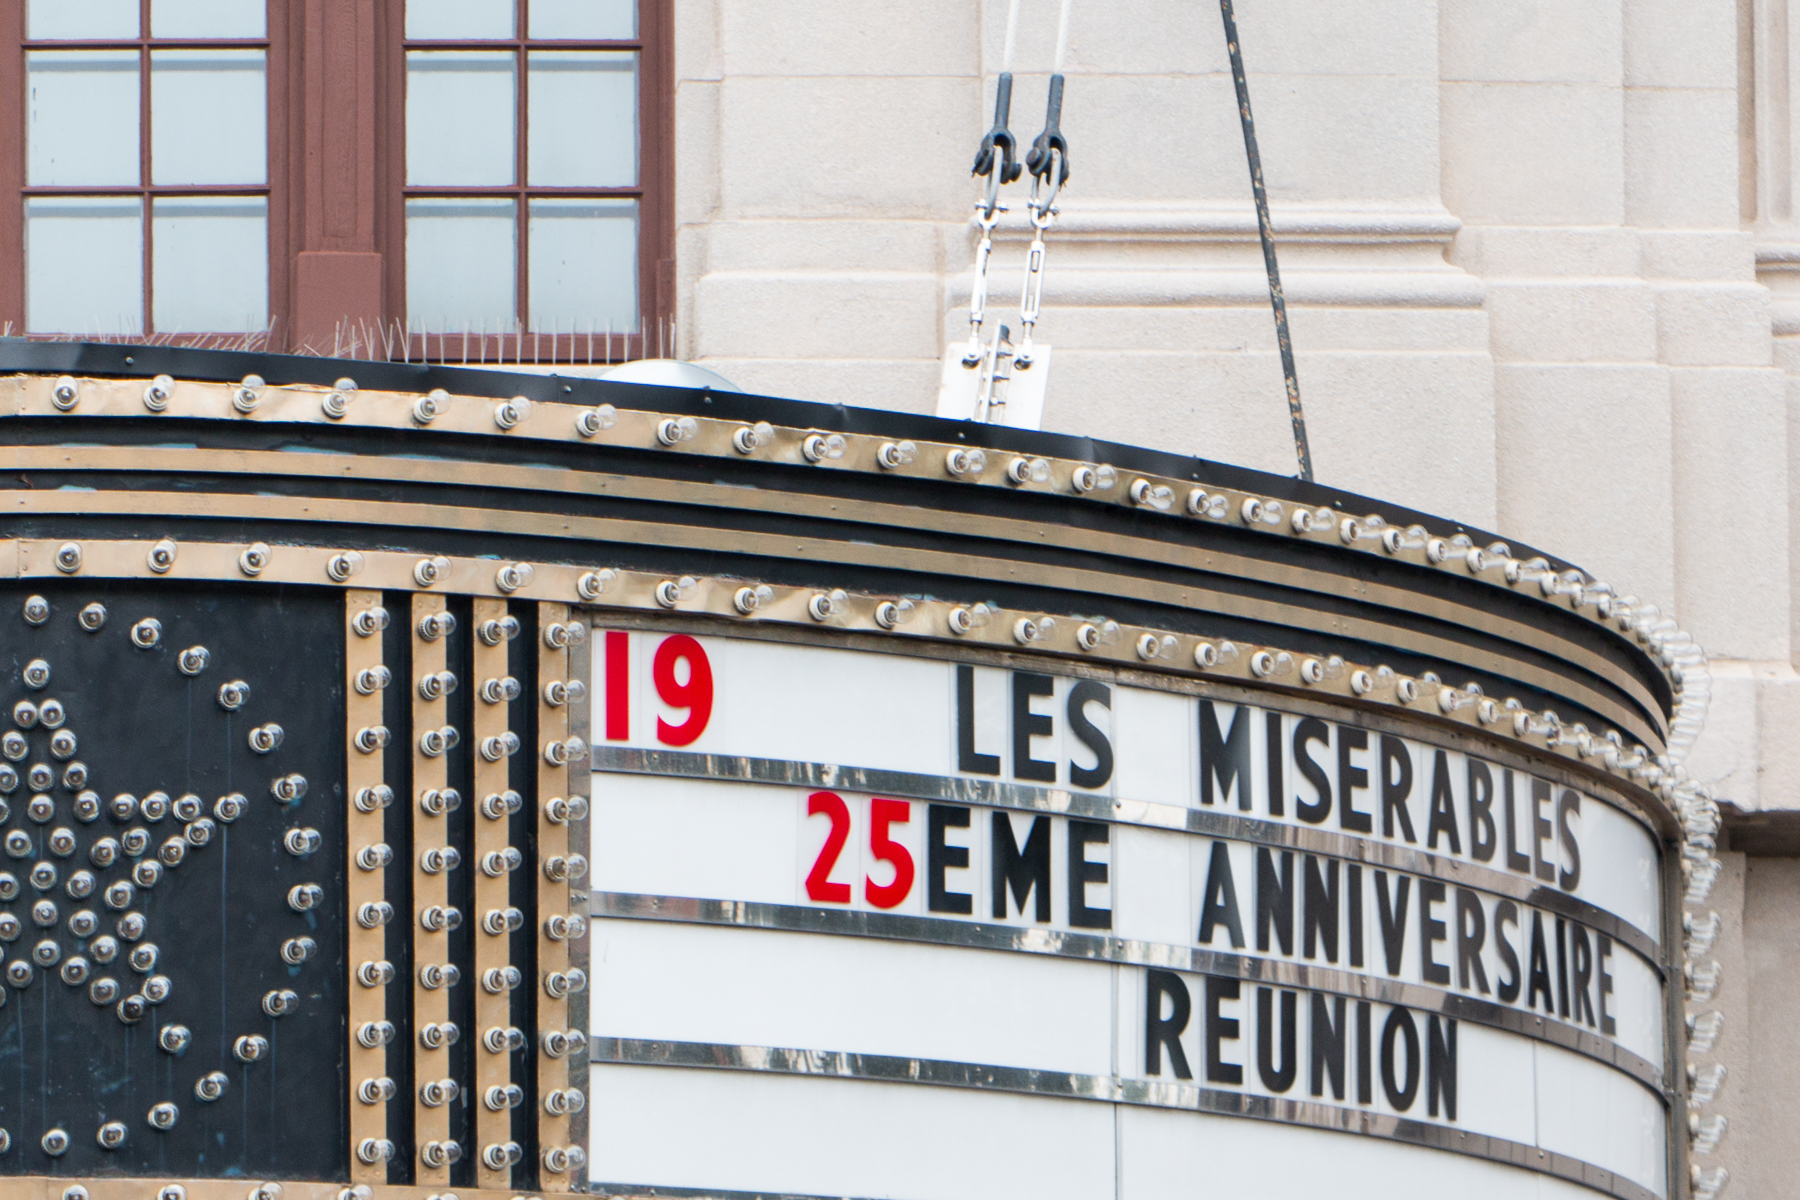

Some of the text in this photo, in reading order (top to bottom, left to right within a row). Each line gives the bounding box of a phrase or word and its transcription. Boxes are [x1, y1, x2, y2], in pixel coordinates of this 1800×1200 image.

[604, 630, 1582, 894] 19 LES MISERABLES
[804, 790, 1618, 1038] 25EME ANNIVERSAIRE
[1145, 970, 1460, 1123] REUNION
